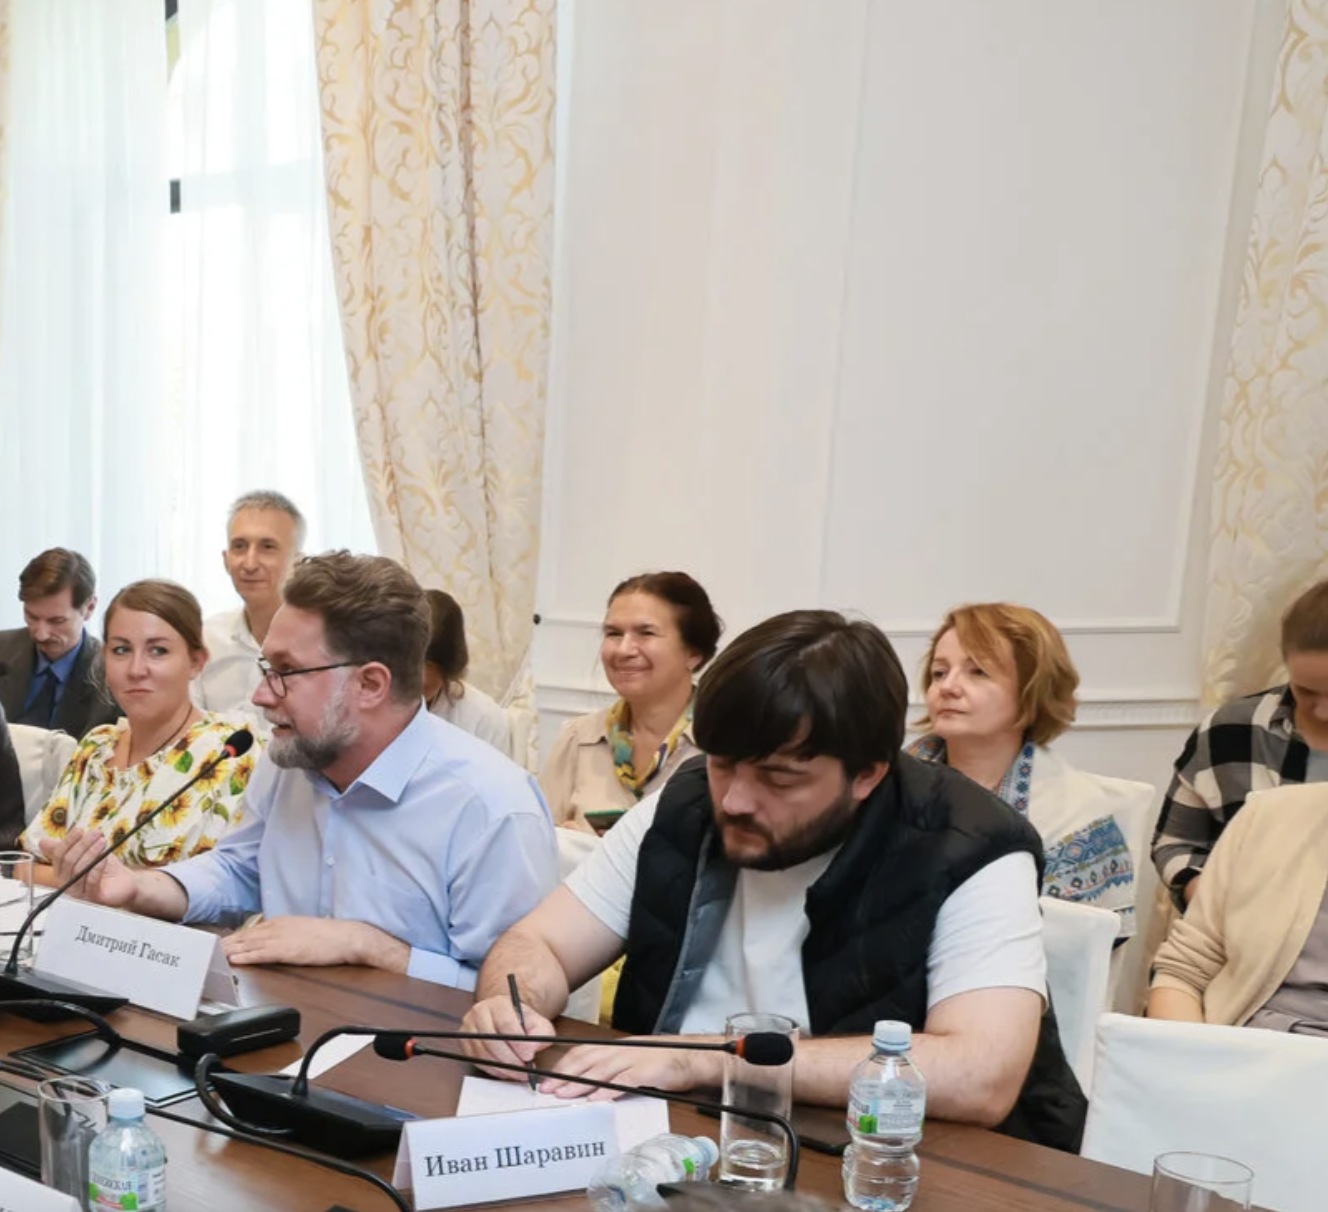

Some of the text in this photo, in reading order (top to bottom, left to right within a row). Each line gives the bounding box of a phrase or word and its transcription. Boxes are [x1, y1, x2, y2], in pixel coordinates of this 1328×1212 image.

[75, 924, 181, 968] Дмитрий Гасак
[424, 1140, 606, 1178] Иван Шаравин
